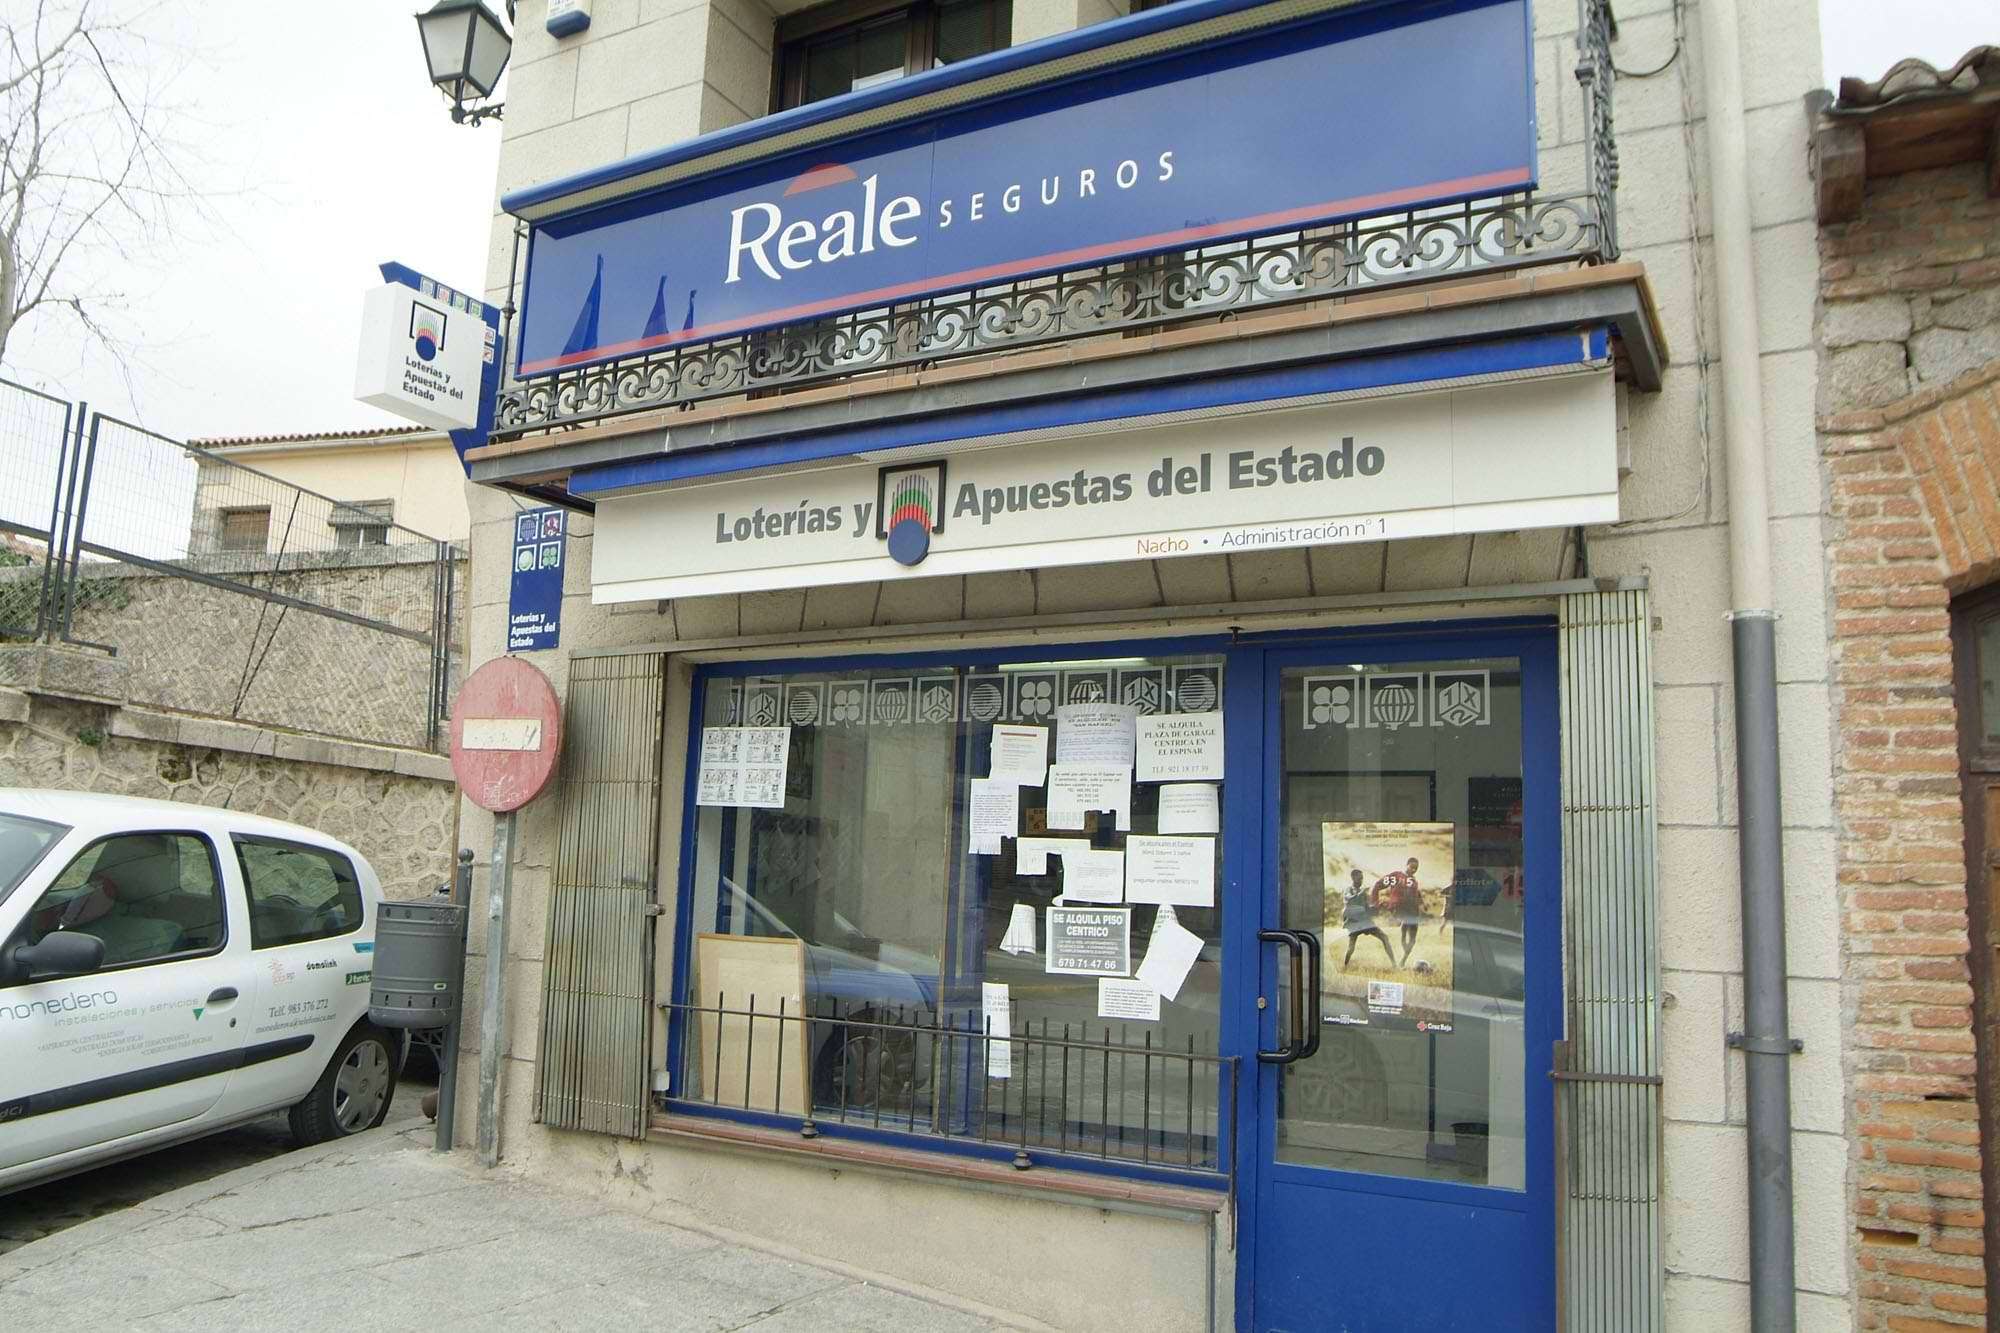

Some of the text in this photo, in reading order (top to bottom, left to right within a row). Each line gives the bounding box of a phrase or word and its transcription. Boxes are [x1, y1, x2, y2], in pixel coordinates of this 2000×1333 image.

[724, 151, 1174, 284] Reale SEGUROS
[405, 355, 443, 380] Loterías
[403, 382, 435, 402] Estado
[404, 370, 463, 400] Apuestas del
[716, 437, 1386, 544] Loterías y Apuestas del Estado
[1136, 536, 1189, 554] Nacho
[1221, 520, 1350, 547] Administración
[1378, 518, 1386, 534] 1
[511, 622, 556, 637] Apuestas del
[510, 636, 534, 648] Estado
[1169, 721, 1204, 729] ALQUILA
[1144, 731, 1170, 739] PLAZA
[1170, 748, 1204, 756] ESPINAR
[1053, 913, 1123, 925] SE ALQUILA PISO
